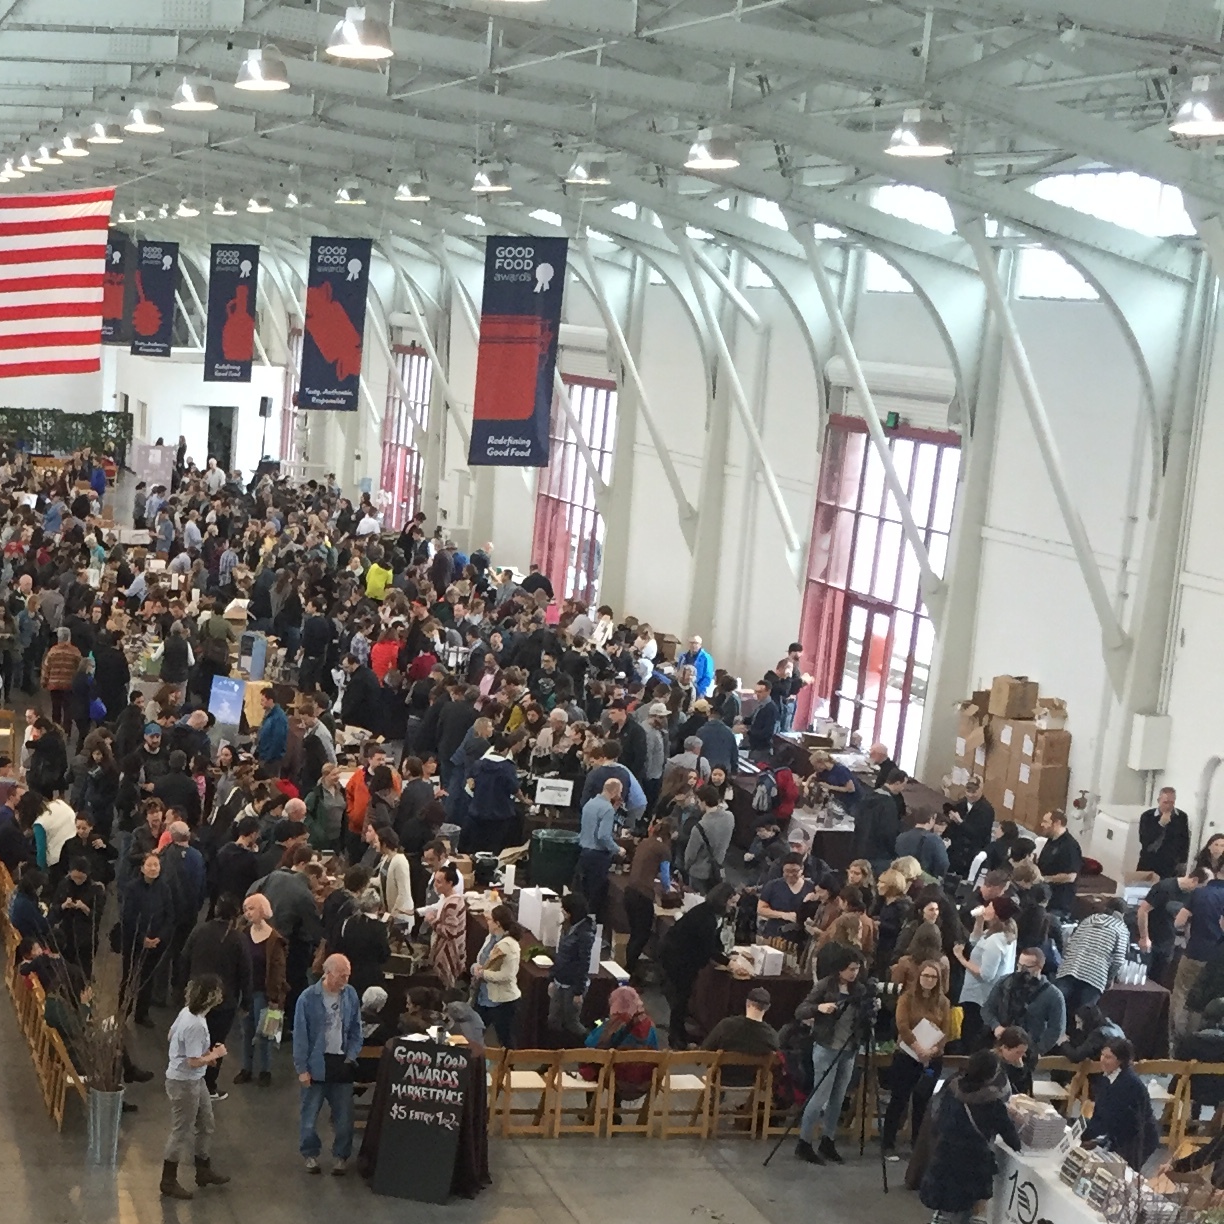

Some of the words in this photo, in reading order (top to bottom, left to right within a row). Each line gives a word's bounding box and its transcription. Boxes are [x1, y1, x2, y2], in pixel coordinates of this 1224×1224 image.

[317, 246, 347, 255] GOOD
[496, 246, 534, 258] GOOD
[216, 257, 239, 265] FOOD
[317, 255, 347, 264] FOOD
[495, 259, 533, 270] FOOD
[494, 272, 532, 282] awards
[487, 436, 531, 448] Redefining
[486, 447, 510, 457] Good
[510, 447, 531, 457] Food
[394, 1045, 432, 1065] GOOD
[436, 1051, 468, 1068] FOOD
[403, 1063, 460, 1088] AWARDS
[389, 1102, 407, 1120] $5
